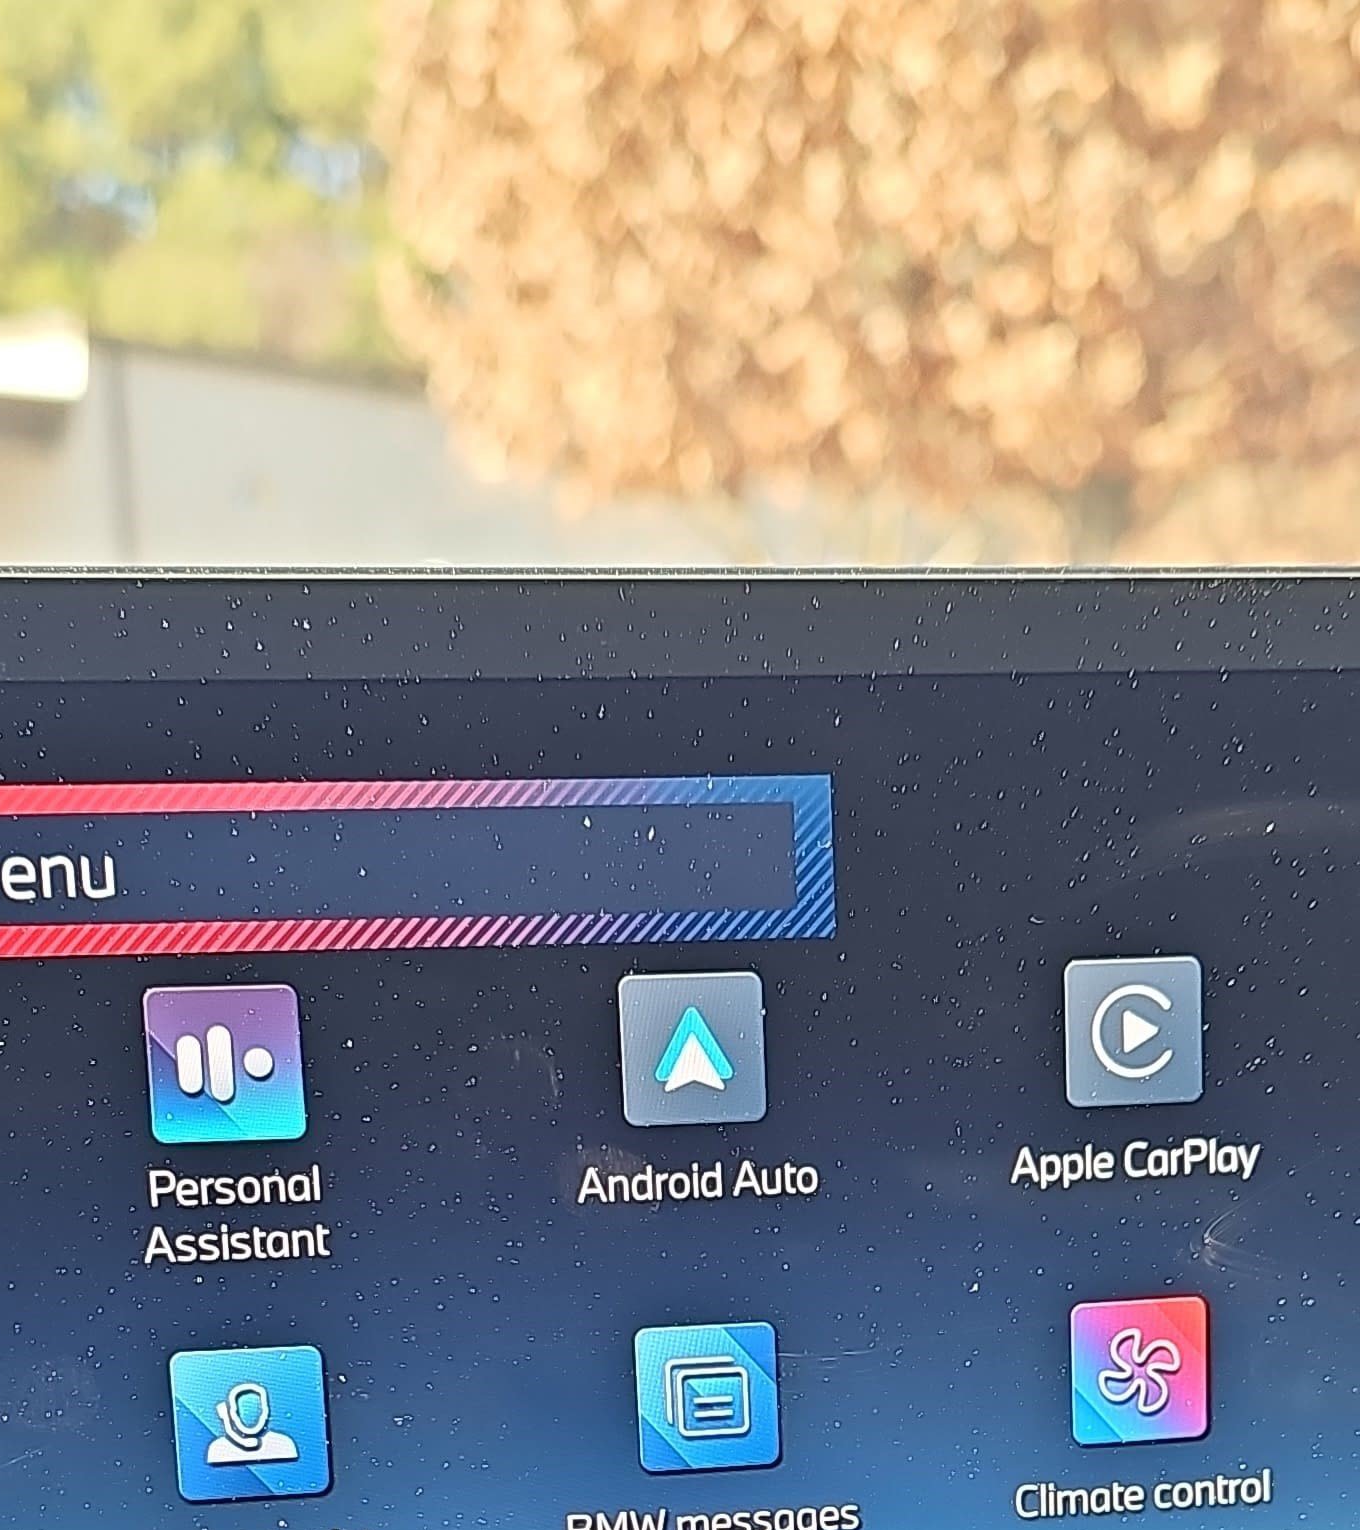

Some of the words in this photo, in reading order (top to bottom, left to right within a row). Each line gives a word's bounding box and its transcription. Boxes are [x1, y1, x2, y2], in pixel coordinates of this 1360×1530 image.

[148, 1163, 323, 1208] Personal
[577, 1161, 724, 1204] Android
[732, 1161, 819, 1198] Auto
[1011, 1145, 1114, 1188] Apple
[1124, 1138, 1262, 1182] CarPlay
[144, 1224, 331, 1264] Assistant
[1015, 1483, 1145, 1521] Climate
[1153, 1471, 1272, 1510] control
